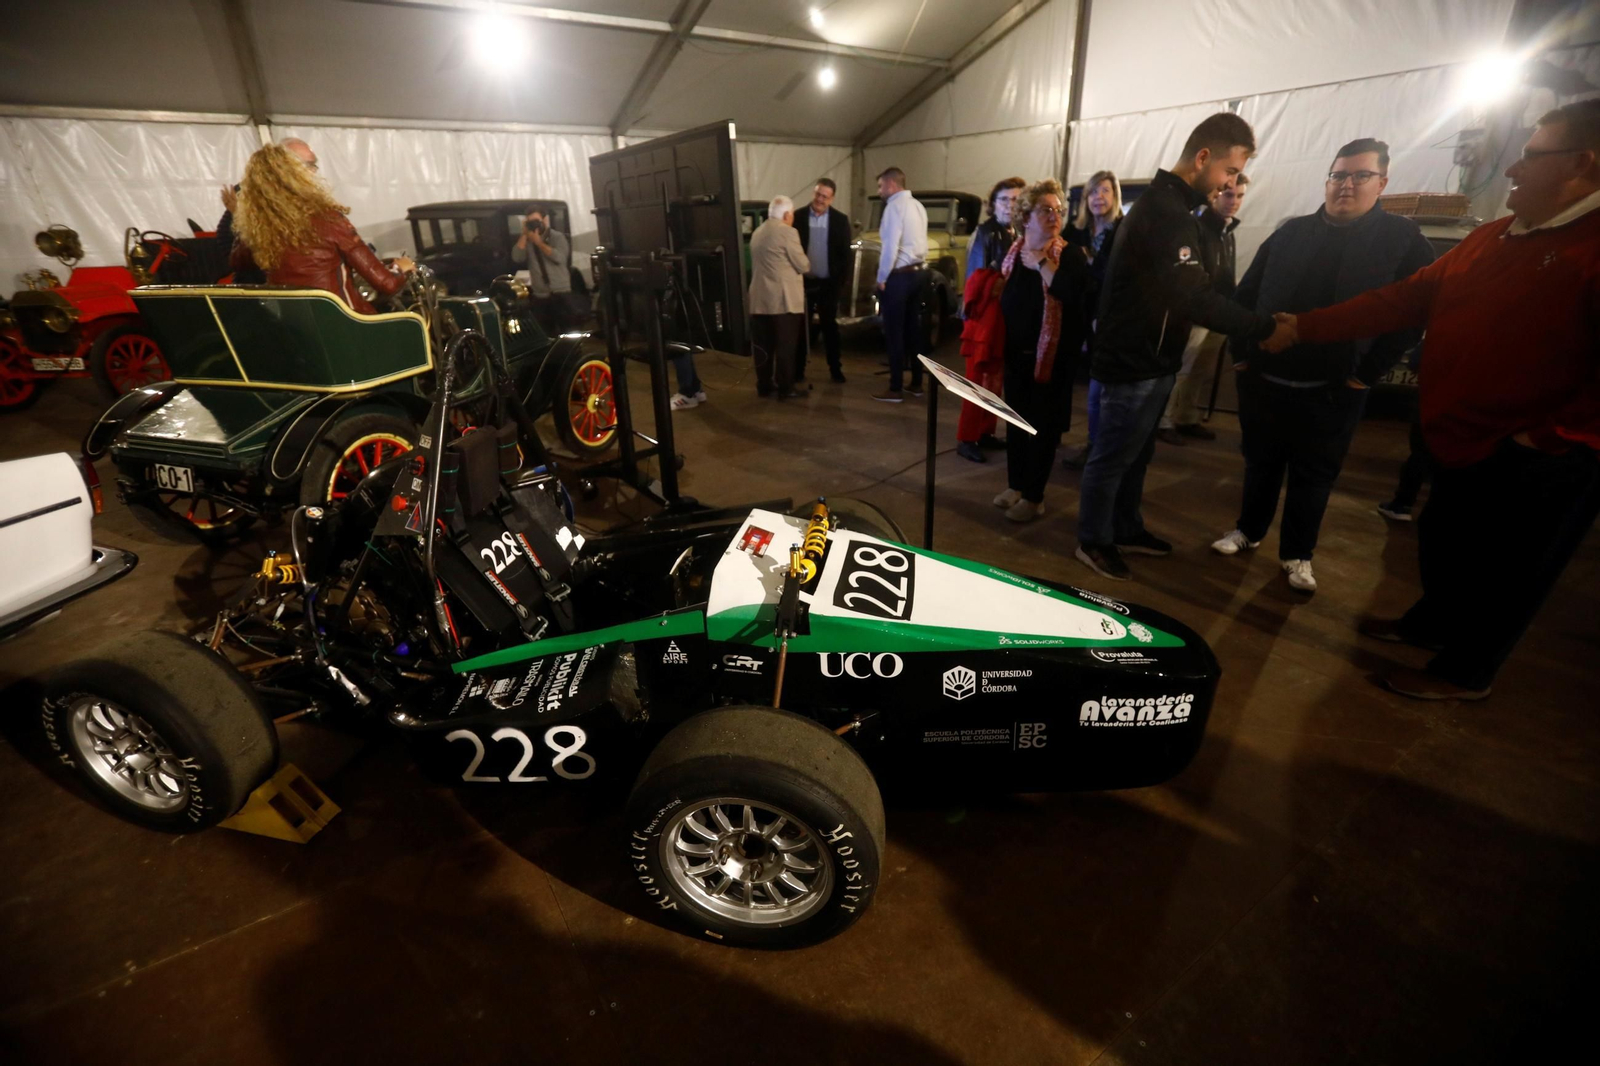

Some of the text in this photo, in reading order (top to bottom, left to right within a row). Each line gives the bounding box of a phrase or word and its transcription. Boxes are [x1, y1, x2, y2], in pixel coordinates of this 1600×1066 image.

[157, 465, 192, 490] CO-1
[480, 531, 522, 575] 228
[843, 546, 909, 618] 228
[662, 652, 687, 660] AIRE
[816, 651, 904, 679] UCO
[547, 652, 577, 711] Publikit
[981, 670, 1033, 679] UNIVERSIDAD
[981, 684, 1018, 693] CÓRDOBA
[1079, 699, 1191, 721] Avanza
[1019, 722, 1047, 736] EP
[1148, 716, 1188, 726] Confianza
[960, 728, 1010, 736] POLITÉCNICA
[973, 733, 1010, 741] CÓRDOBA
[1018, 735, 1047, 749] SC
[444, 725, 597, 783] 228
[818, 823, 869, 913] Hoosier
